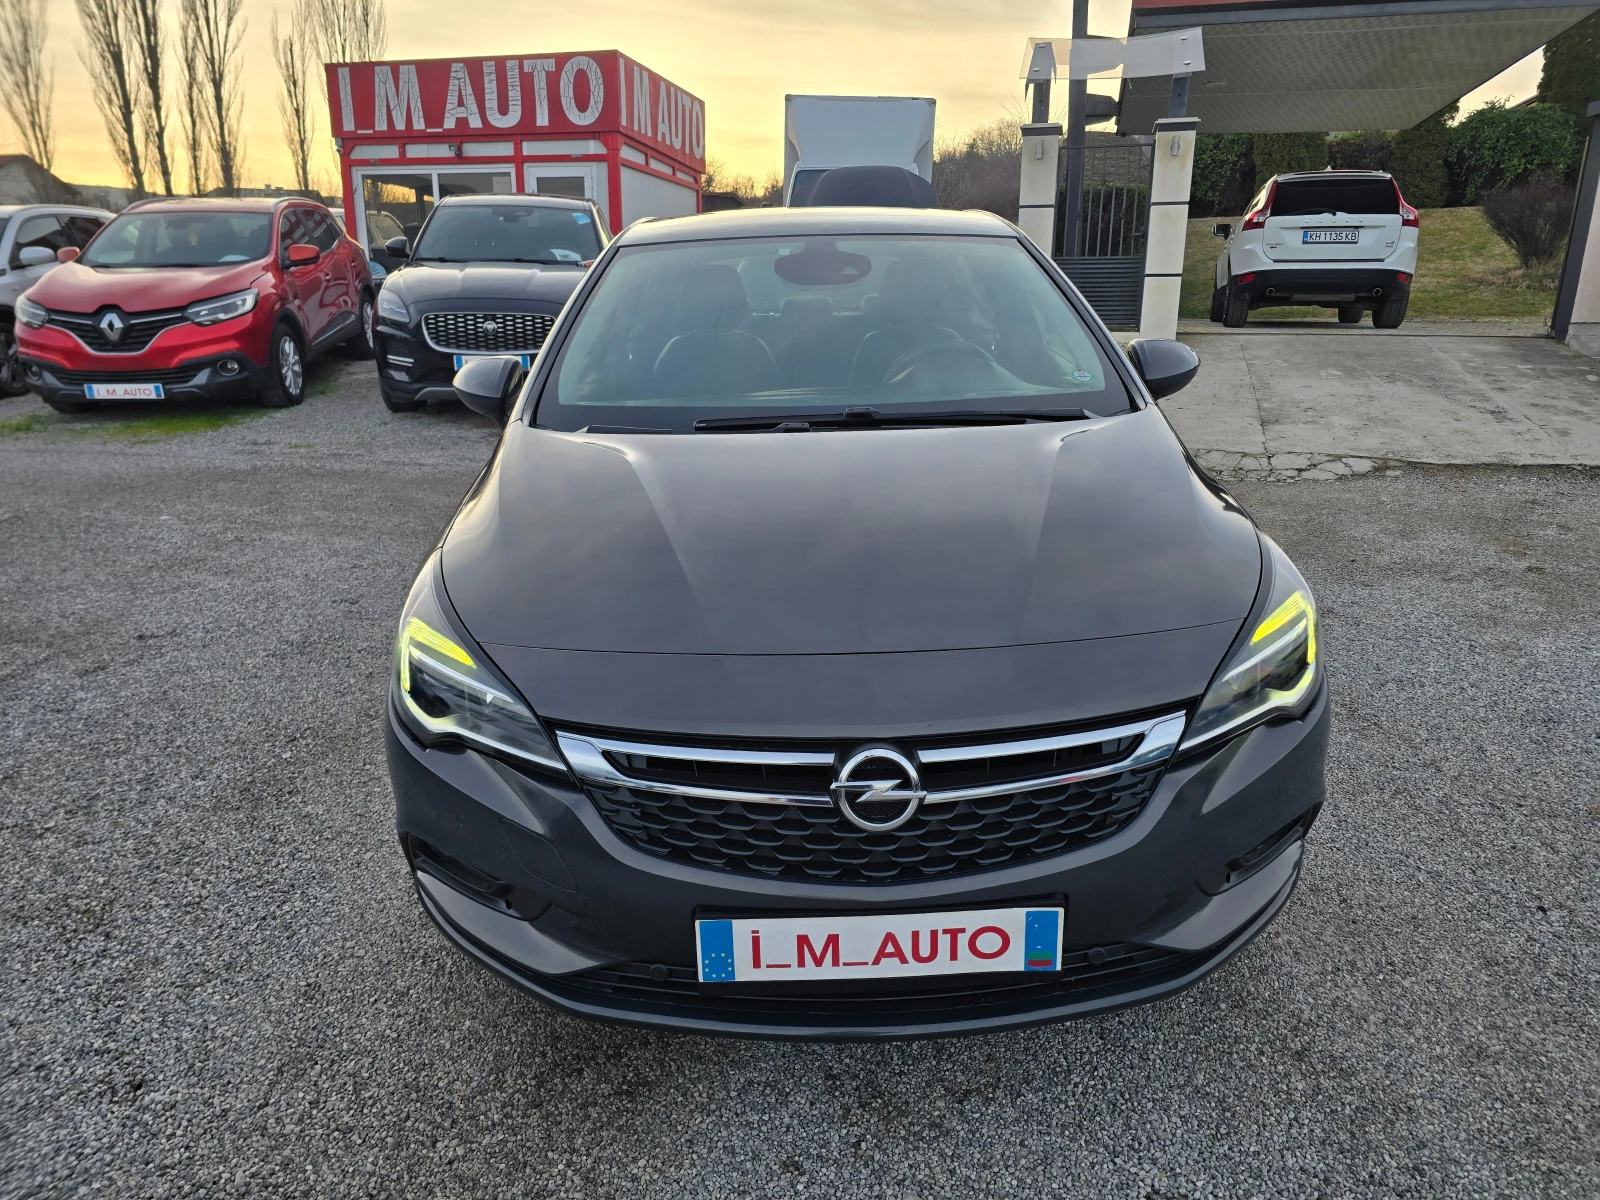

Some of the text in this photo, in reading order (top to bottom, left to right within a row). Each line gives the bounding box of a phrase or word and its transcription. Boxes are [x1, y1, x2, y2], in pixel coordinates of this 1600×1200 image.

[619, 57, 703, 159] I M AUTO
[1308, 231, 1357, 241] KH 1135 KB
